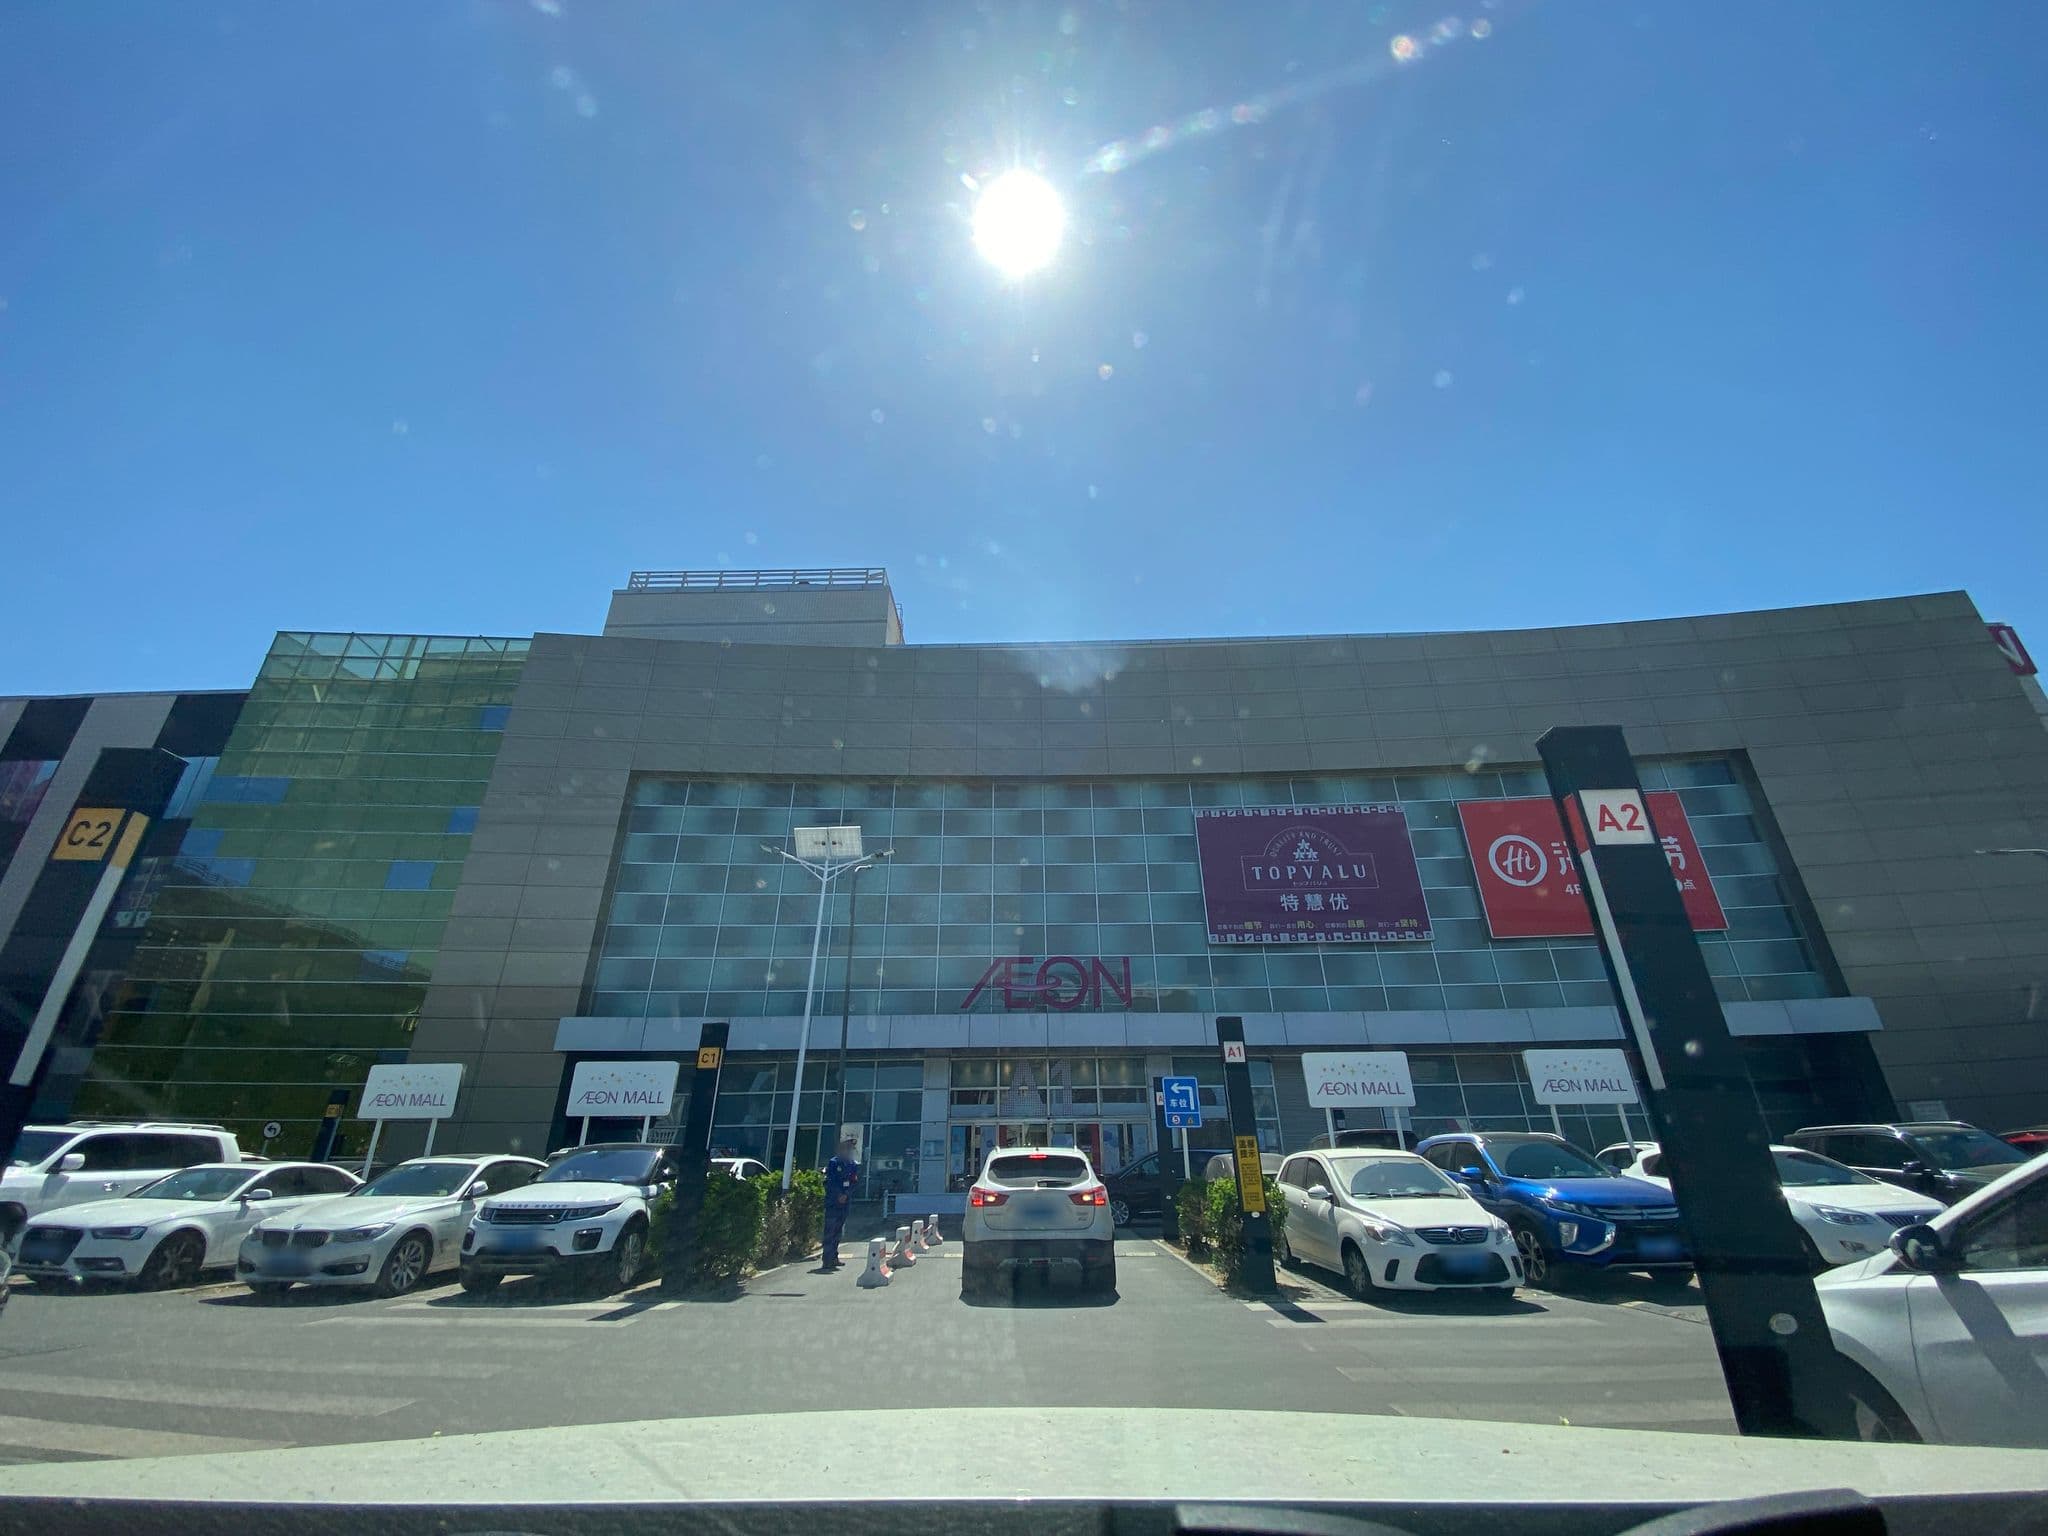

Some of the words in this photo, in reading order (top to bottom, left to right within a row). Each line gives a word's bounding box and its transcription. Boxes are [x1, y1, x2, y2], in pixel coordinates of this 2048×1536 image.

[1598, 804, 1645, 832] A2
[67, 820, 111, 847] C2
[1502, 845, 1536, 875] Hi
[1252, 864, 1366, 881] TOPVALU
[1280, 893, 1349, 912] 特慧优
[701, 1053, 716, 1063] C1
[1227, 1046, 1243, 1058] A1
[1361, 1081, 1405, 1095] MALL
[1584, 1078, 1627, 1092] MALL
[409, 1094, 447, 1107] MALL
[622, 1090, 664, 1104] MALL
